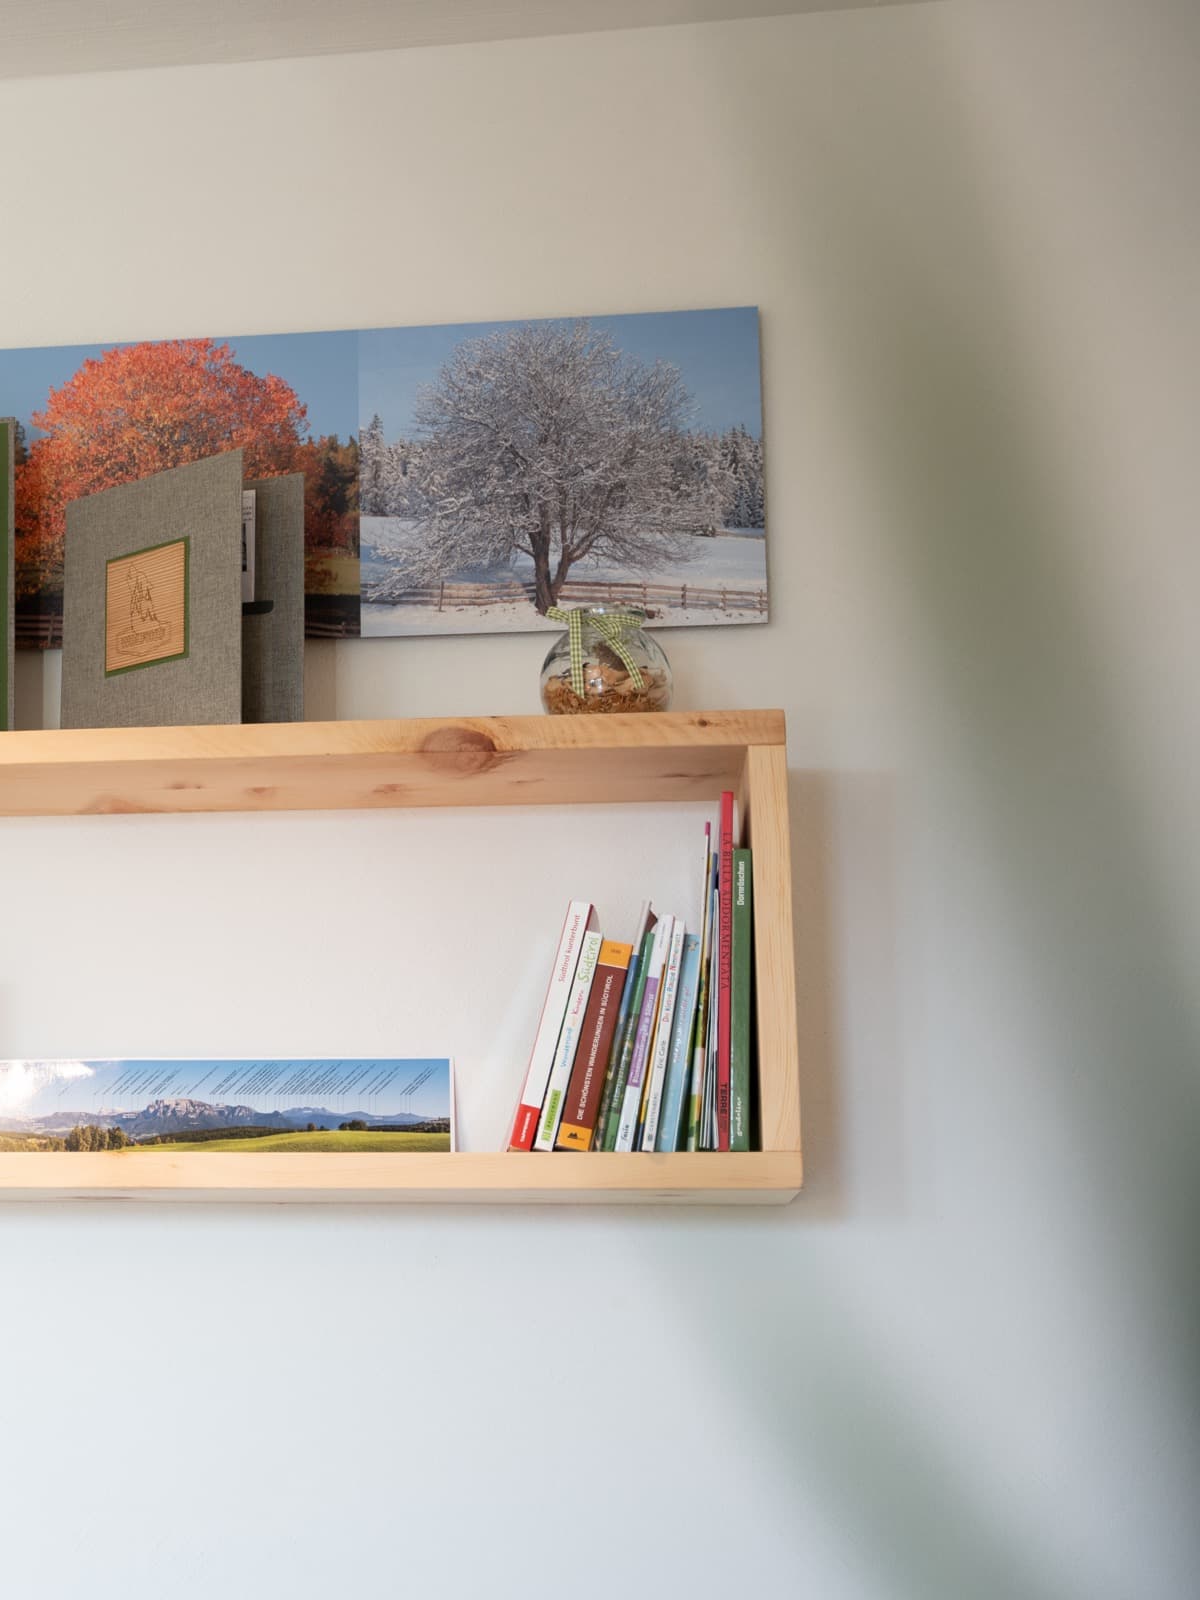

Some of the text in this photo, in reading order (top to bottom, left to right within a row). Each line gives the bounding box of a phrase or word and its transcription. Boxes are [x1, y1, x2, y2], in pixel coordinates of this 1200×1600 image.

[722, 851, 732, 884] BELLA
[736, 861, 745, 906] Dornröschen
[720, 889, 732, 990] ADDORMENTATA
[558, 955, 571, 983] Südtirol
[577, 936, 600, 983] Südtirol
[601, 975, 614, 1007] SÜDTIROL
[599, 1006, 607, 1016] IN
[587, 1016, 605, 1067] WANDERUNGEN
[579, 1067, 595, 1107] SCHÖNSTEN
[576, 1108, 585, 1121] DIE
